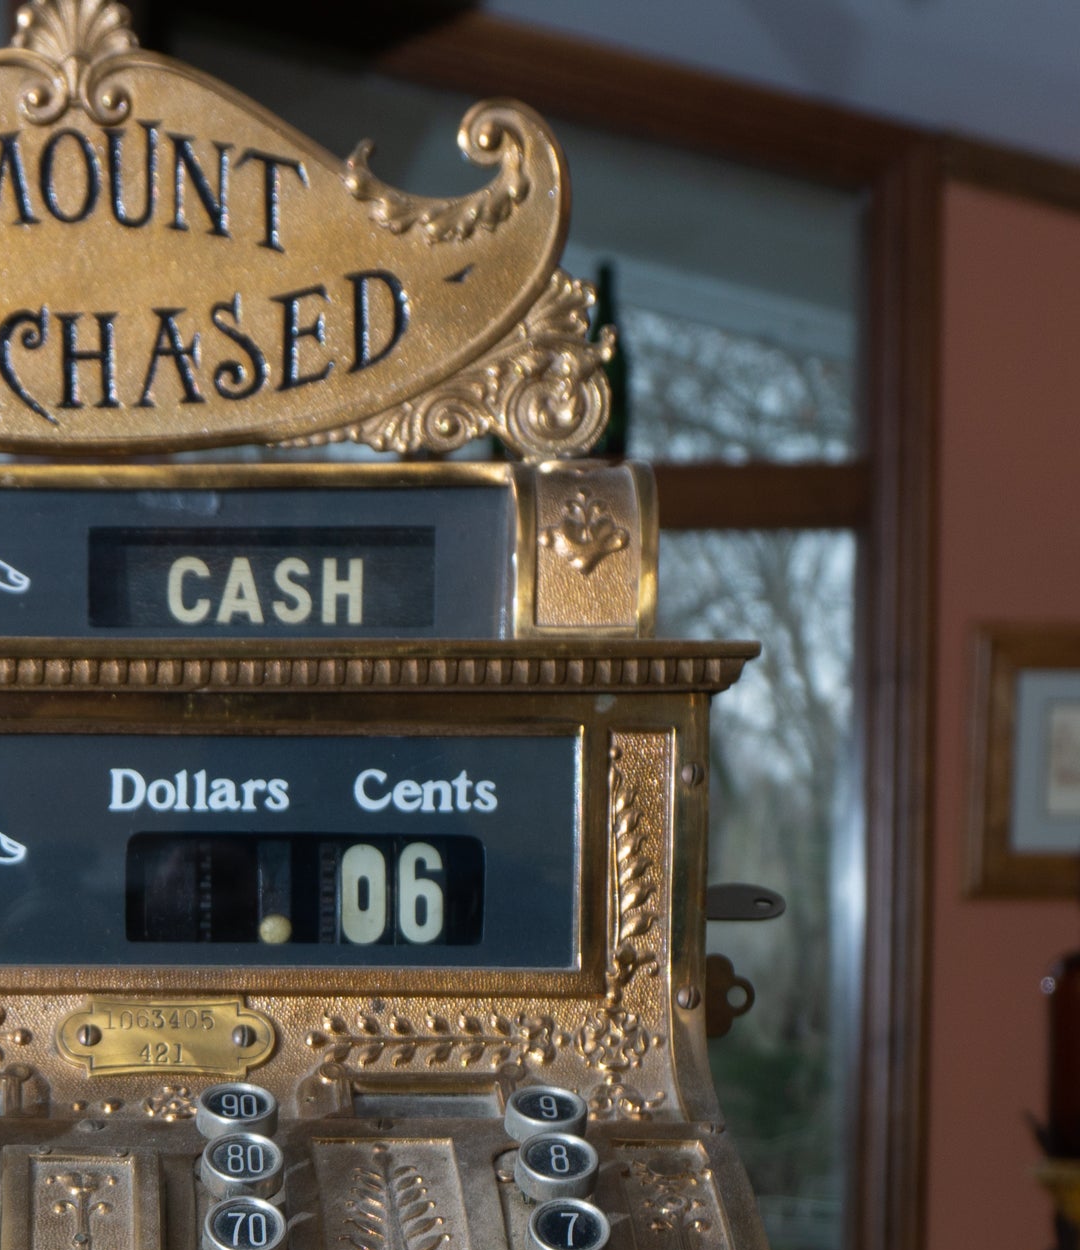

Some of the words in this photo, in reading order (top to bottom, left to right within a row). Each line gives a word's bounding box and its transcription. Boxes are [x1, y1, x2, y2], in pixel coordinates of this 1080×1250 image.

[167, 556, 363, 625] CASH
[109, 767, 289, 813] Dollars
[353, 769, 497, 813] Cents
[342, 842, 443, 944] 06
[103, 1009, 216, 1031] 1063405
[139, 1042, 185, 1064] 421
[222, 1094, 258, 1117] 90
[539, 1096, 558, 1118] 9
[227, 1144, 264, 1172] 80
[551, 1144, 569, 1173] 8
[227, 1212, 267, 1246] 70
[561, 1212, 579, 1246] 7
